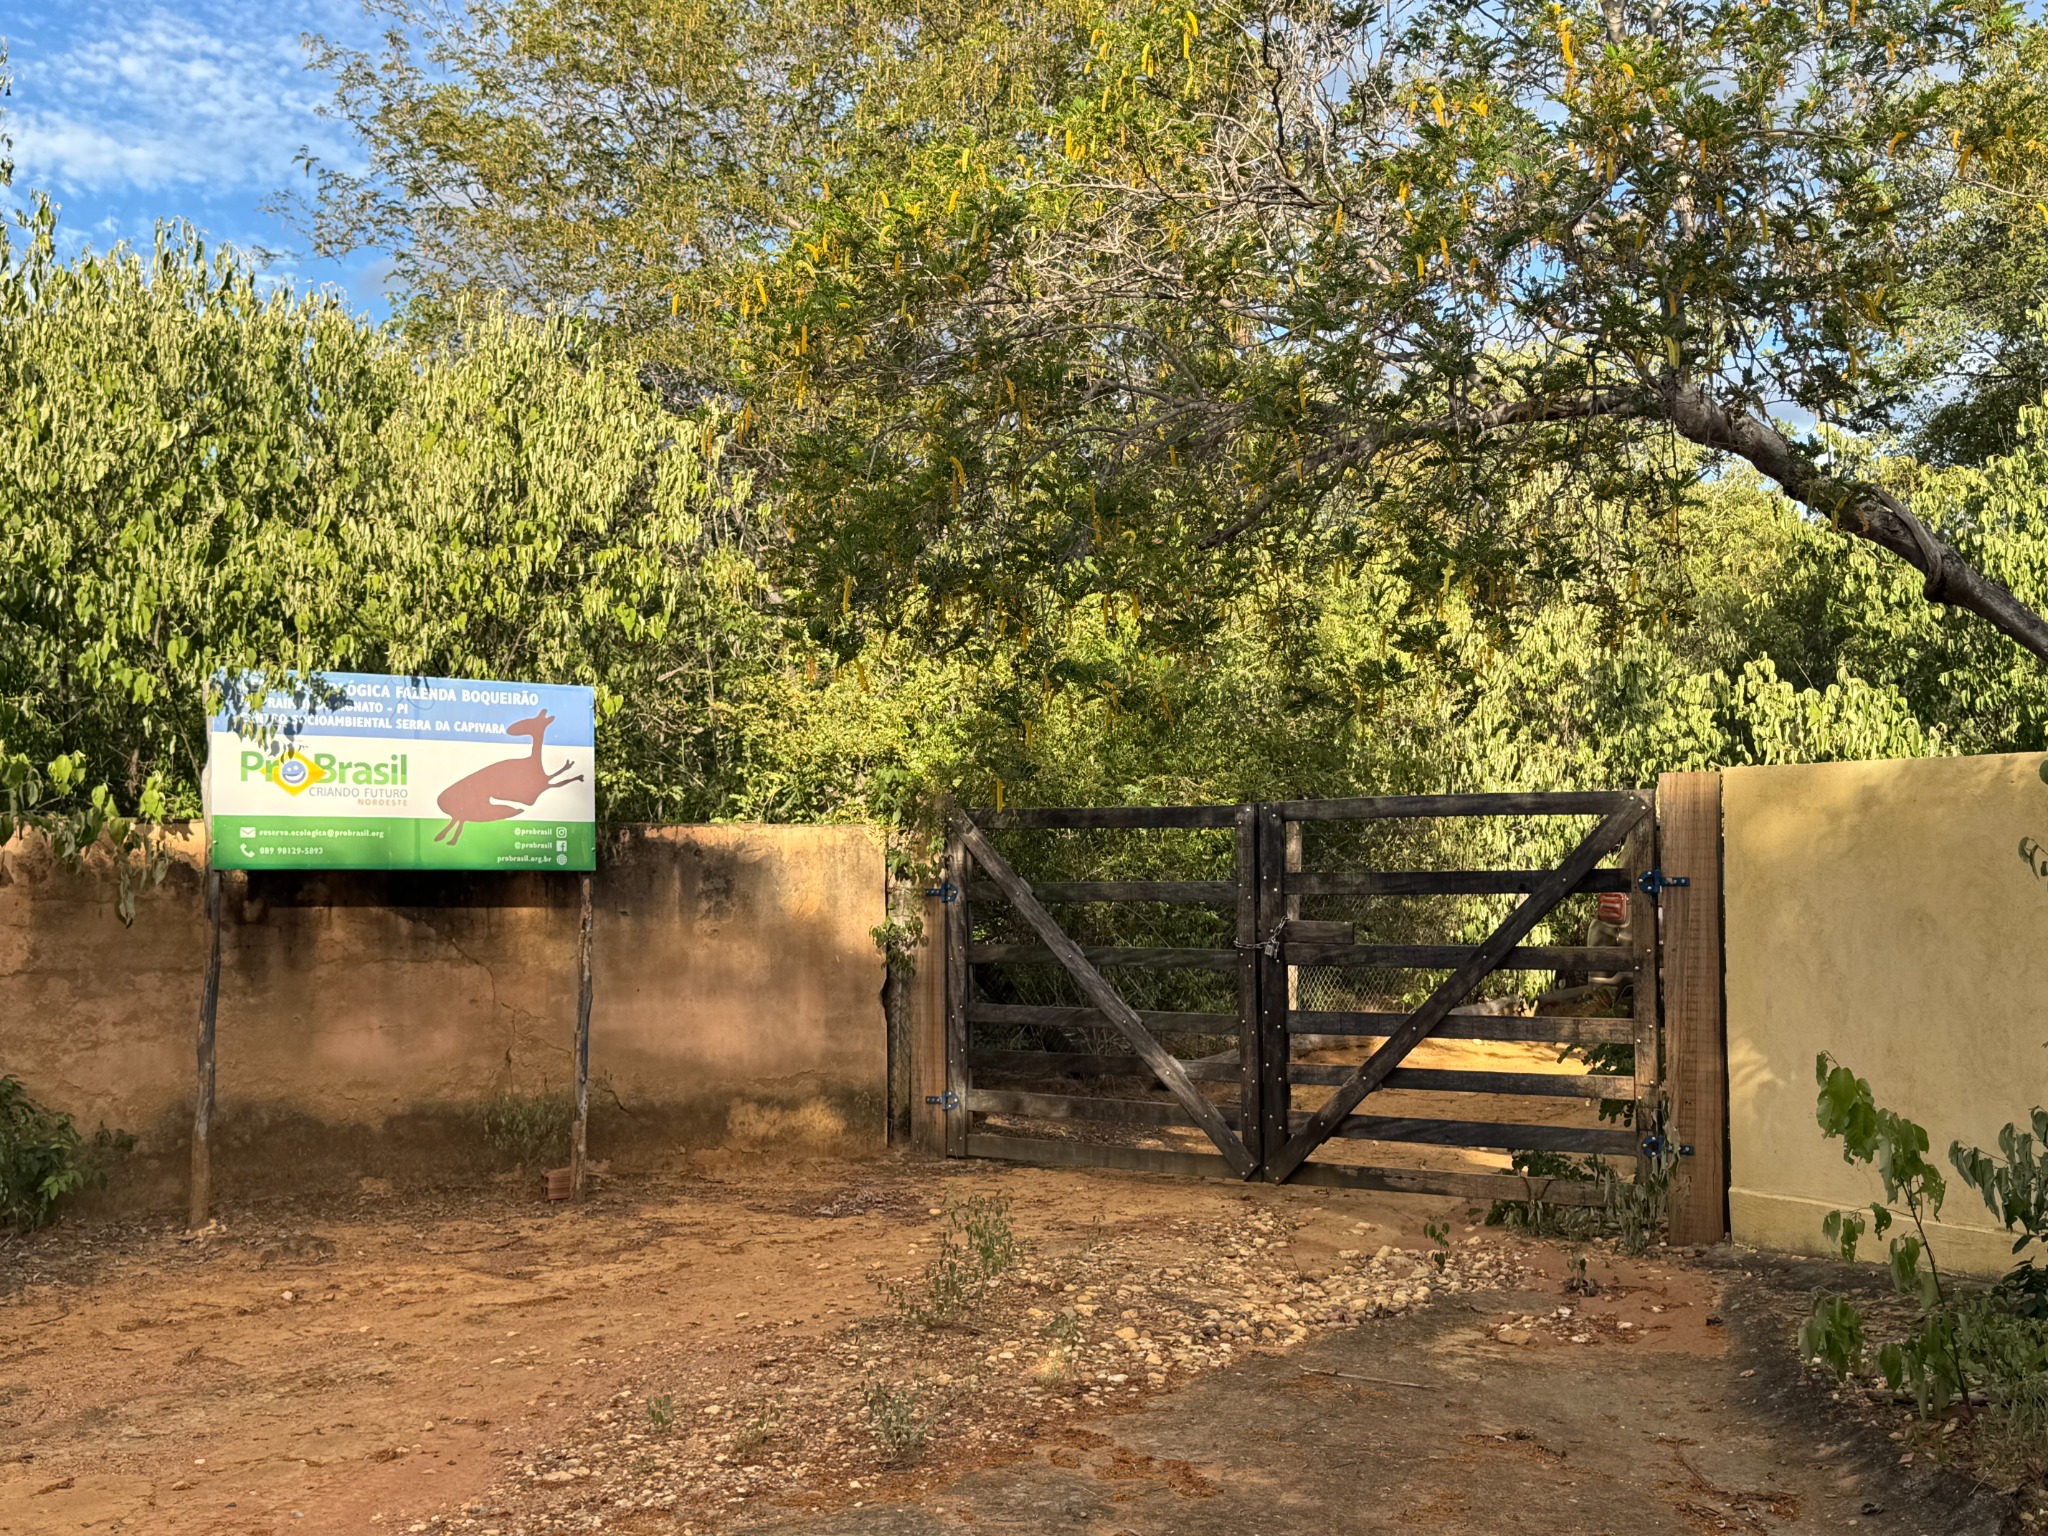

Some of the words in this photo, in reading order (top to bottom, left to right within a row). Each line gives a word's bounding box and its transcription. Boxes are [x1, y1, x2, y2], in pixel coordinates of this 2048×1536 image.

[396, 685, 456, 702] FAZENDA
[462, 690, 539, 706] BOQUEIRÃO
[397, 704, 408, 714] PI
[291, 713, 392, 729] SOCIOAMBIENTAL
[396, 719, 431, 731] SERRA
[435, 720, 449, 732] DA
[454, 721, 506, 734] CAPIVARA
[308, 786, 360, 798] CRIANDO
[364, 787, 408, 799] FUTURO
[259, 828, 384, 839] reserva.ecologica@probrasil.org
[514, 827, 552, 836] @probrasil
[259, 846, 275, 855] 089
[514, 841, 552, 850] @probrasil
[497, 855, 552, 863] probrasil.org.br
